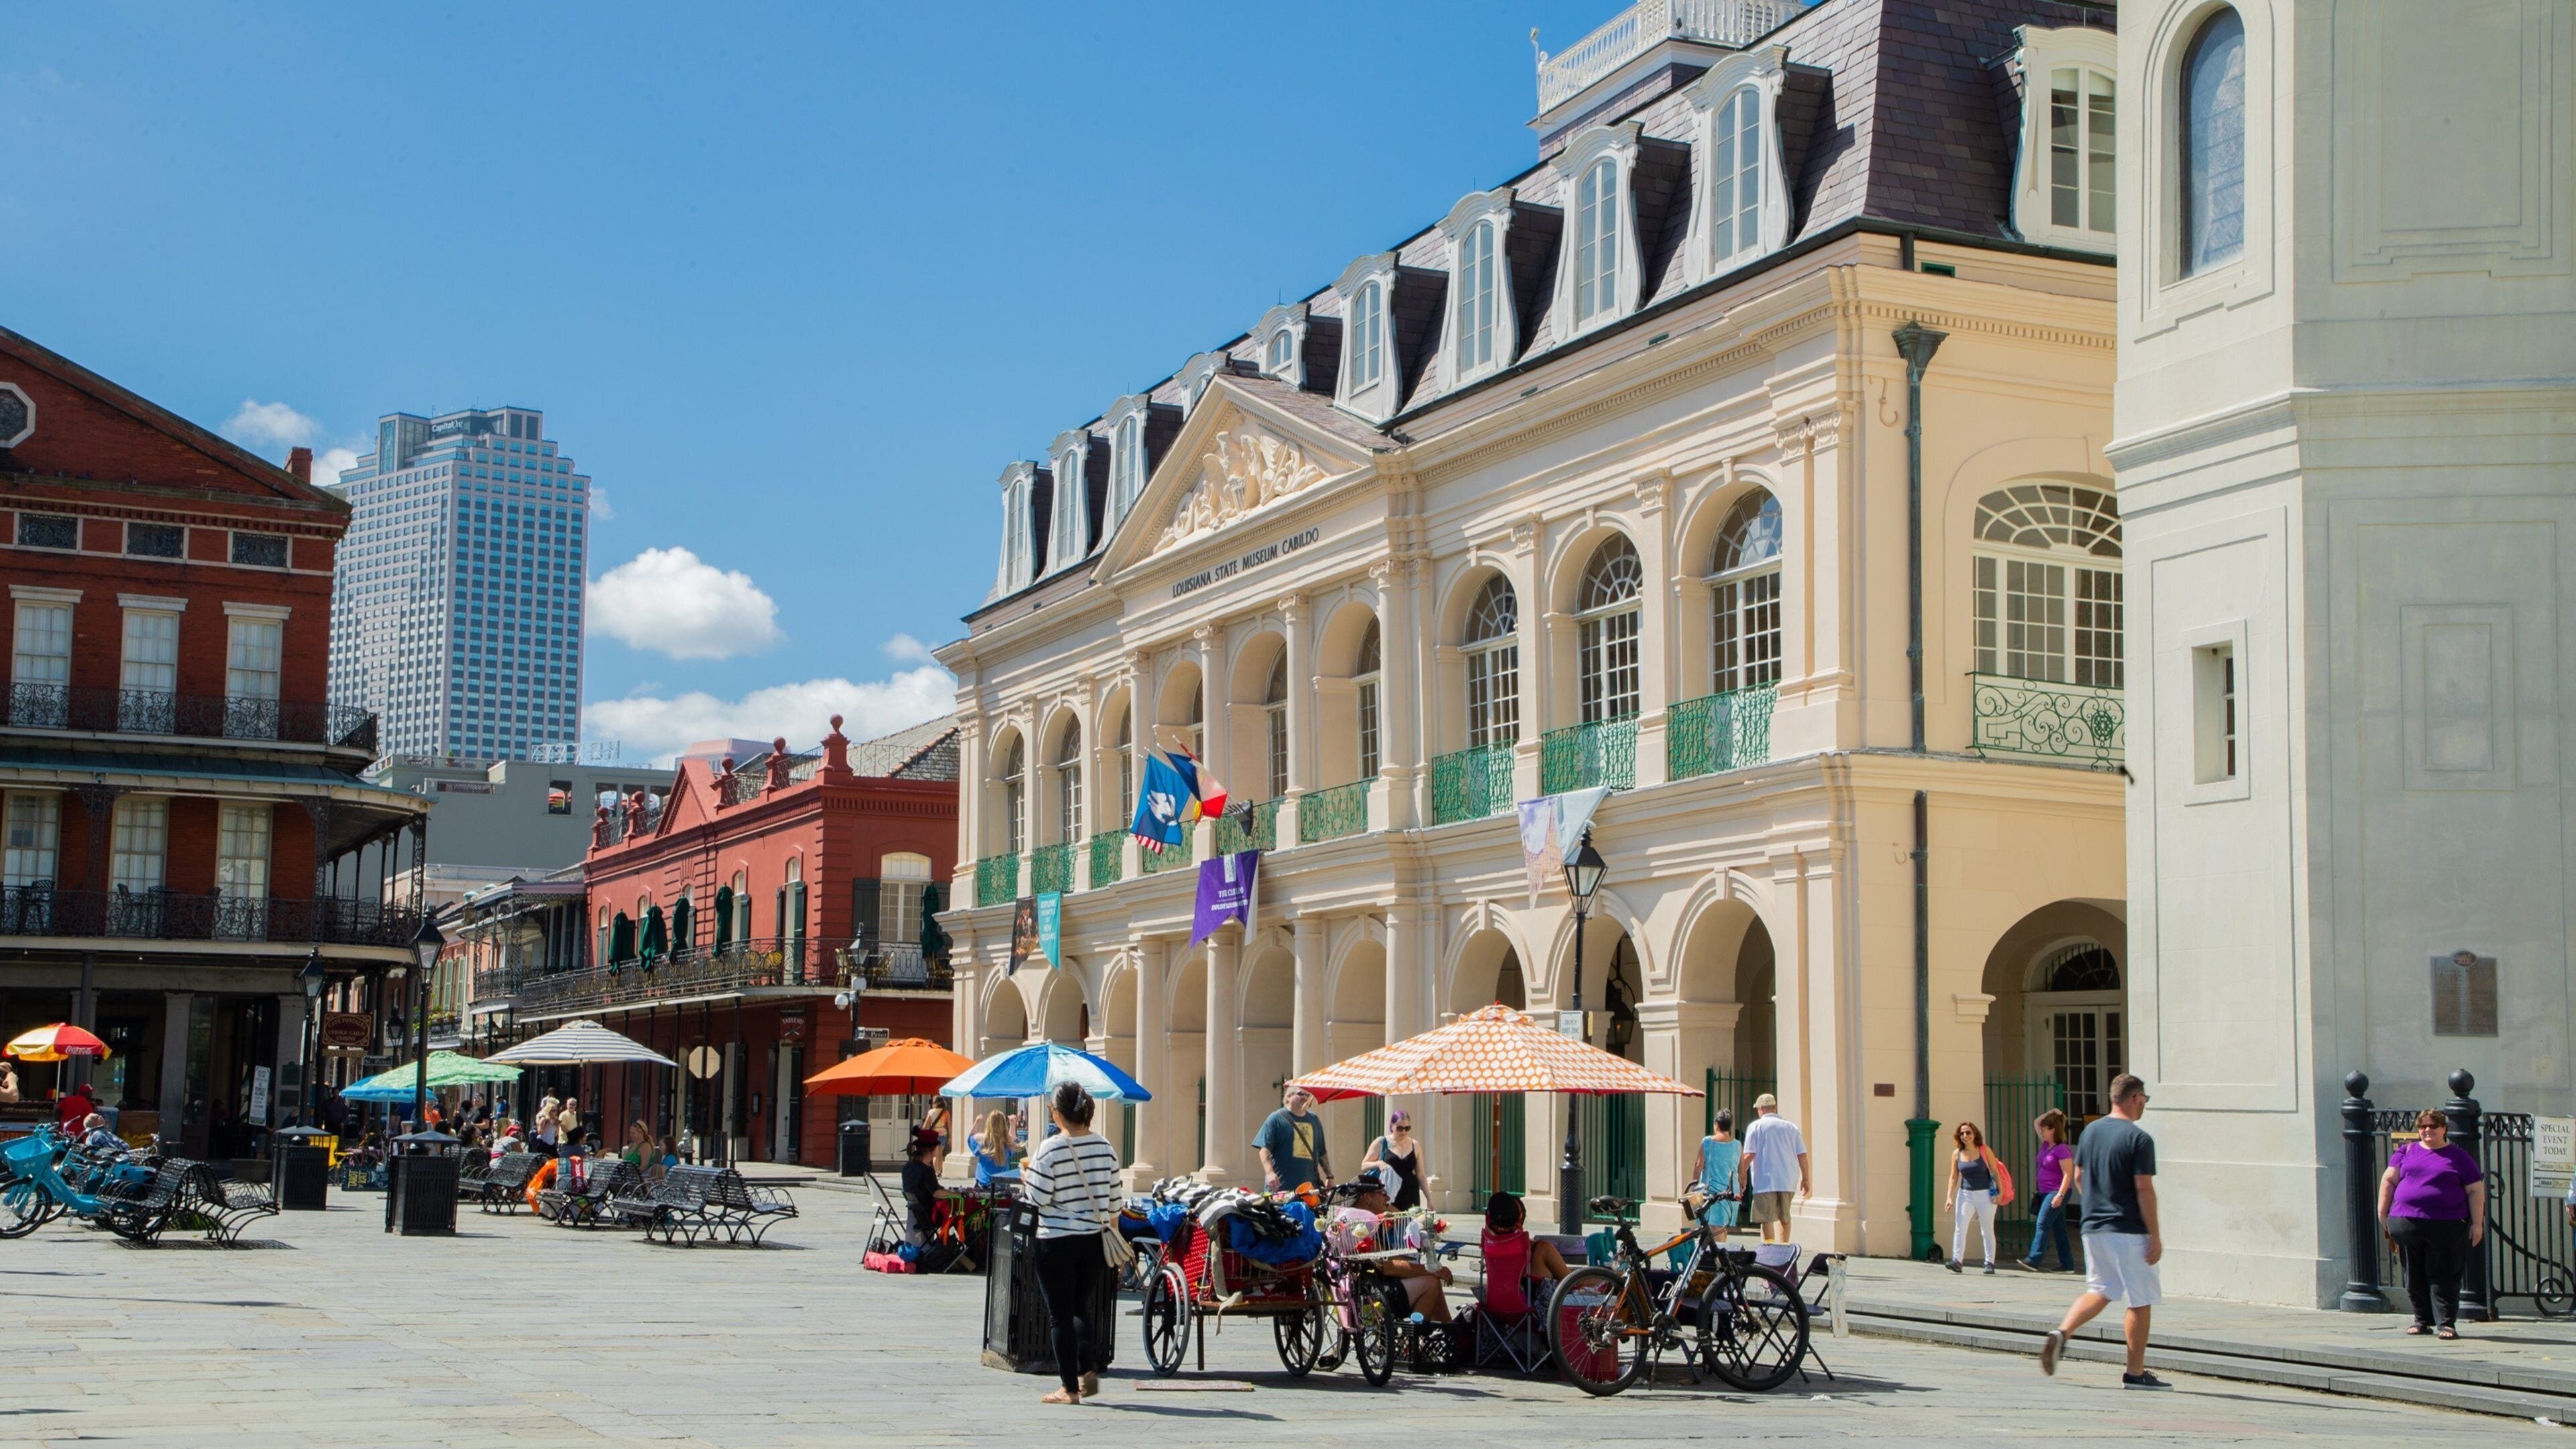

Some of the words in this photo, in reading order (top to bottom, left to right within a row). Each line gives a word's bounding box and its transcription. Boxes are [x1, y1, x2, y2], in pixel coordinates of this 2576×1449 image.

[1173, 571, 1212, 598] LOUISIANA
[1215, 560, 1238, 581] STATE
[1242, 544, 1278, 570] MUSEUM
[1282, 527, 1319, 554] CABILDO
[2540, 1124, 2570, 1133] SPECIAL
[2543, 1135, 2568, 1144] EVENT
[2543, 1146, 2568, 1155] TODAY
[1681, 1246, 1705, 1290] TREK
